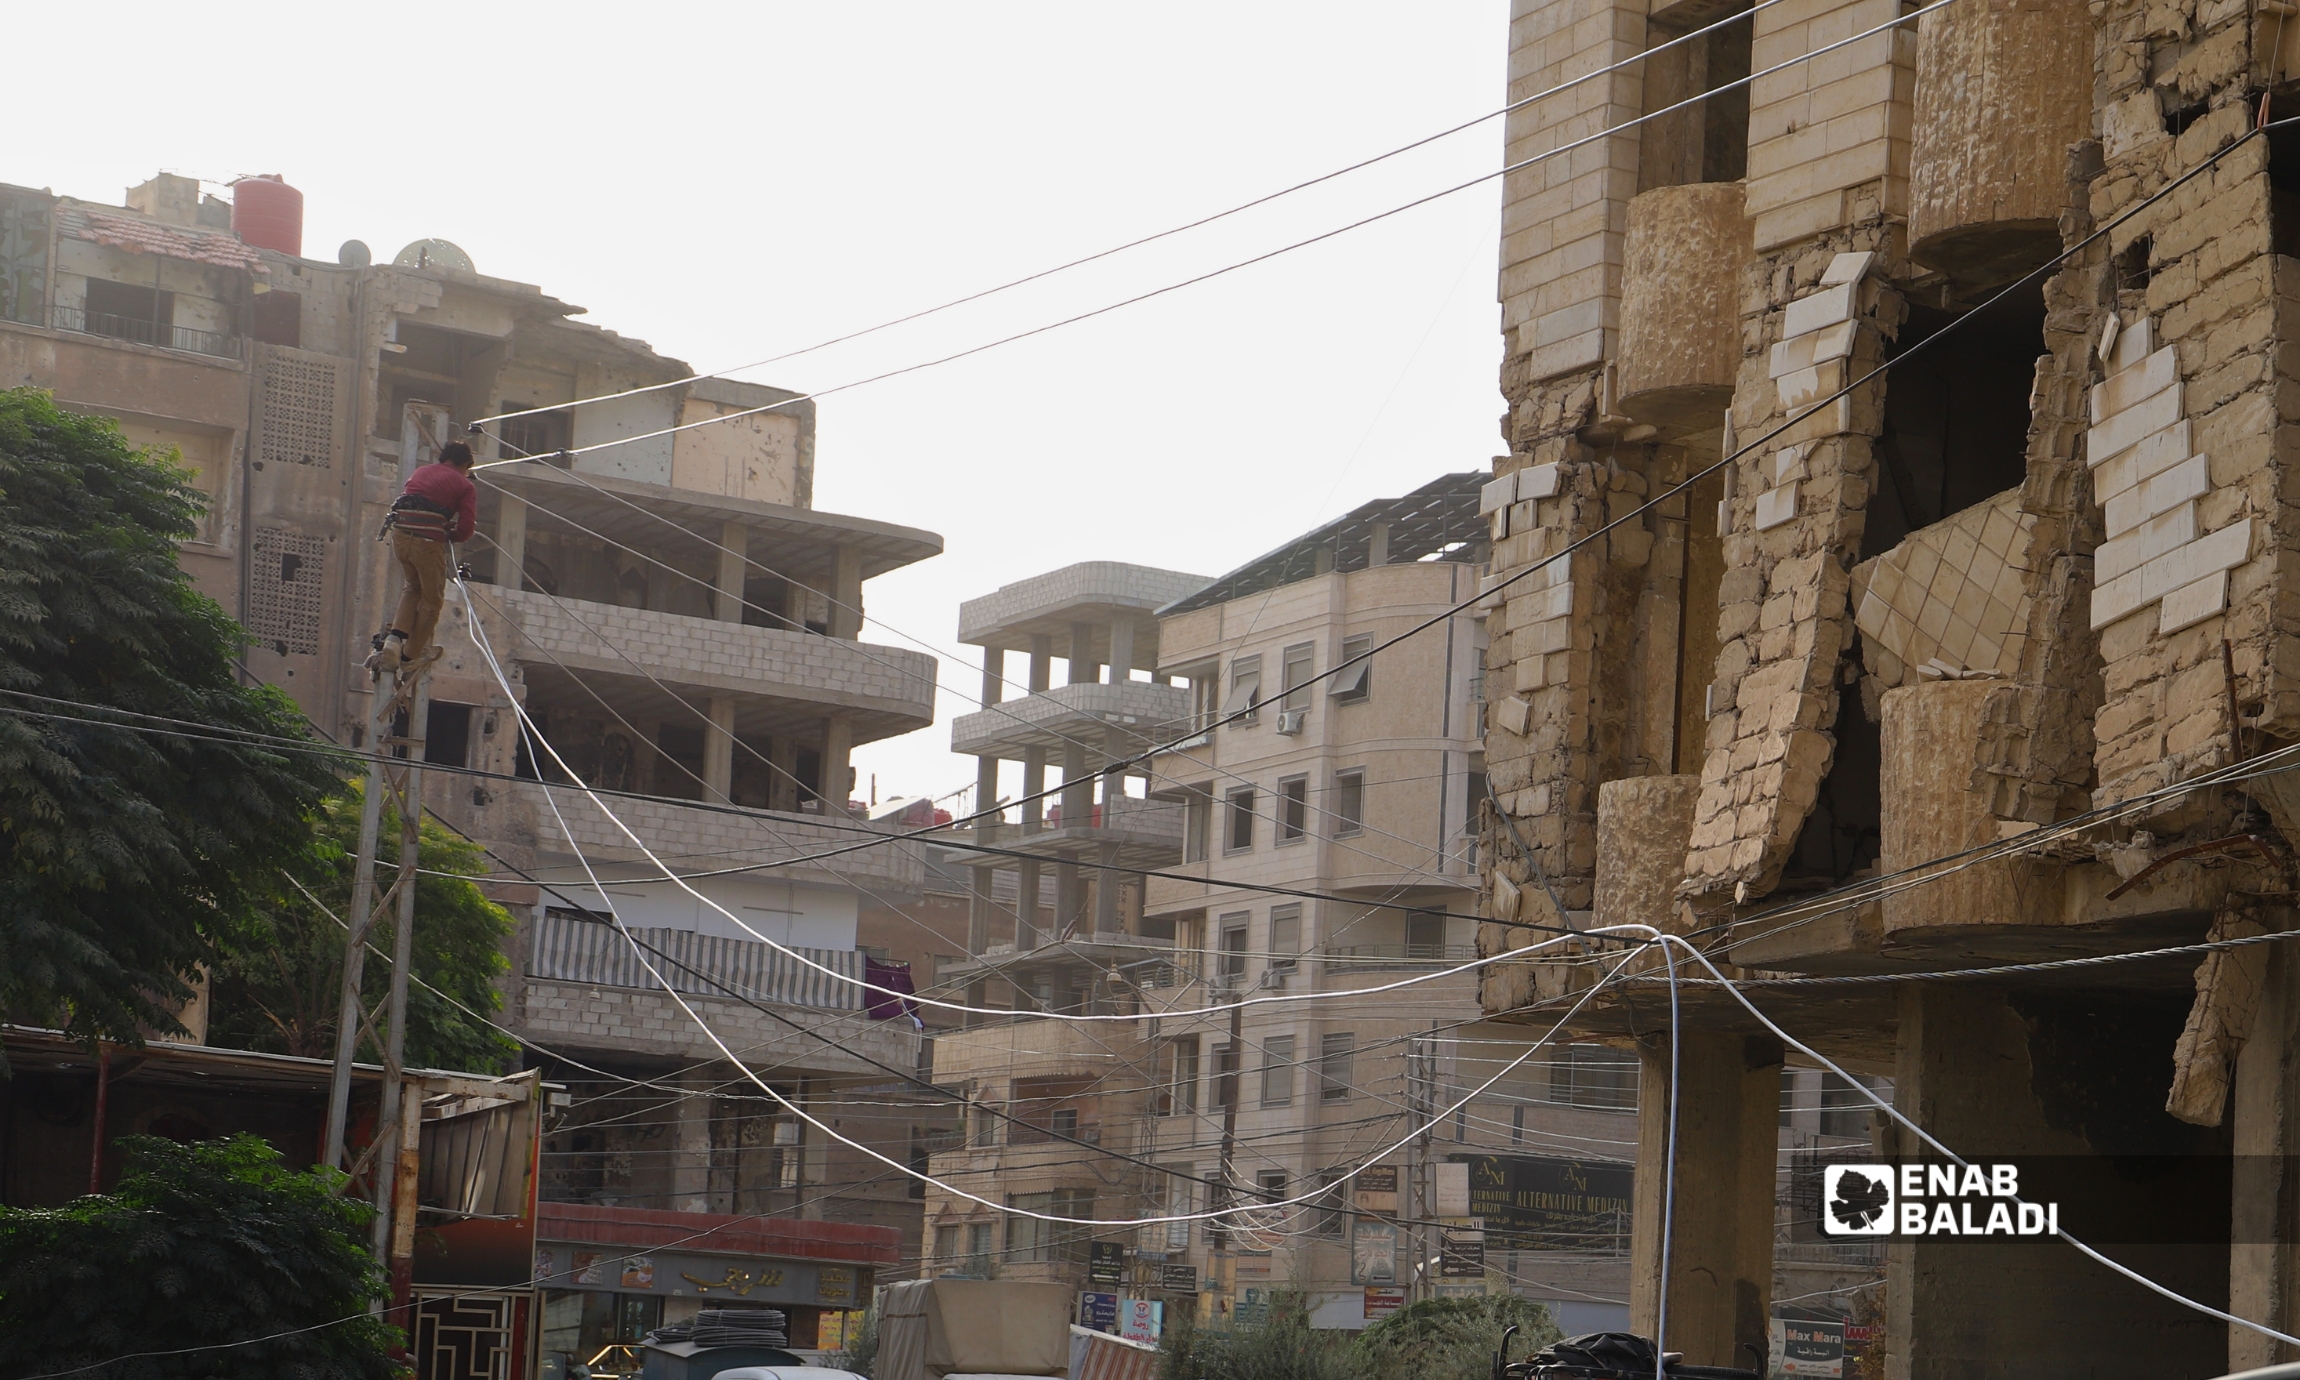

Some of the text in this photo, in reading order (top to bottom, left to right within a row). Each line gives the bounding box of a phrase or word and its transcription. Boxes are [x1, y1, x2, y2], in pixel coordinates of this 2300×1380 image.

[1469, 1190, 1510, 1202] LTERNATIVE
[1516, 1191, 1628, 1213] ALTERNATIVE MEDIZIN
[1472, 1202, 1501, 1213] MEDIZIN
[1786, 1328, 1811, 1342] Max
[1813, 1331, 1841, 1344] Mara
